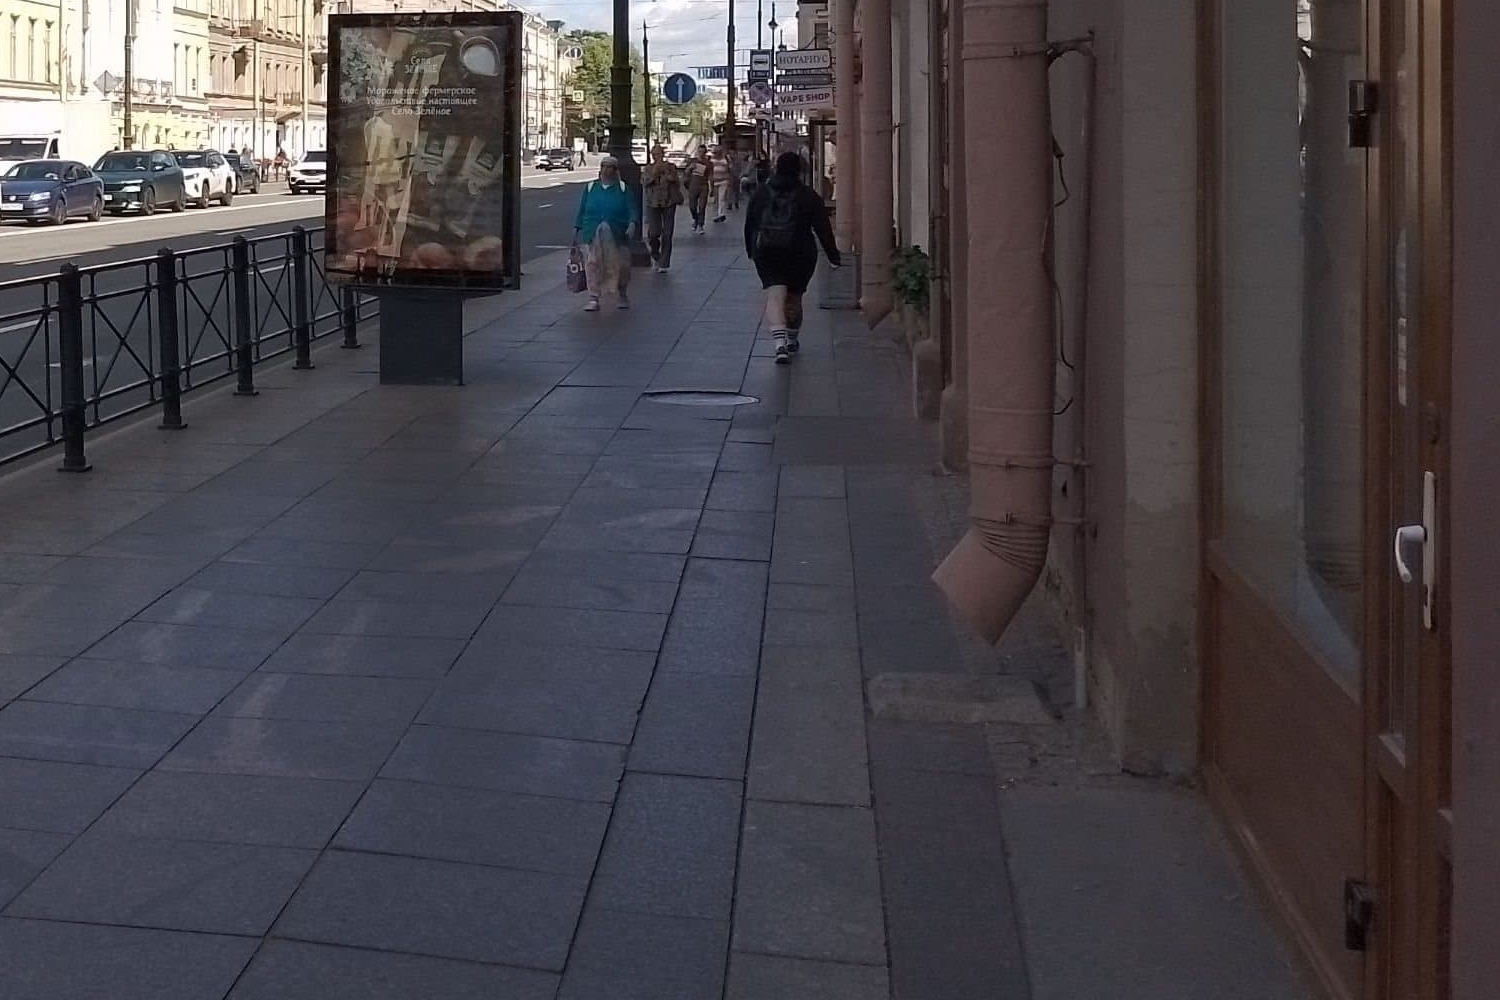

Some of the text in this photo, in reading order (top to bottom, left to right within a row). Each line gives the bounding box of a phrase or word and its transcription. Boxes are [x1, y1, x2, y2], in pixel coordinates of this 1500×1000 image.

[779, 55, 828, 65] НОТАРИУС
[421, 86, 477, 97] фермерское
[780, 92, 830, 104] VAPE SHOP
